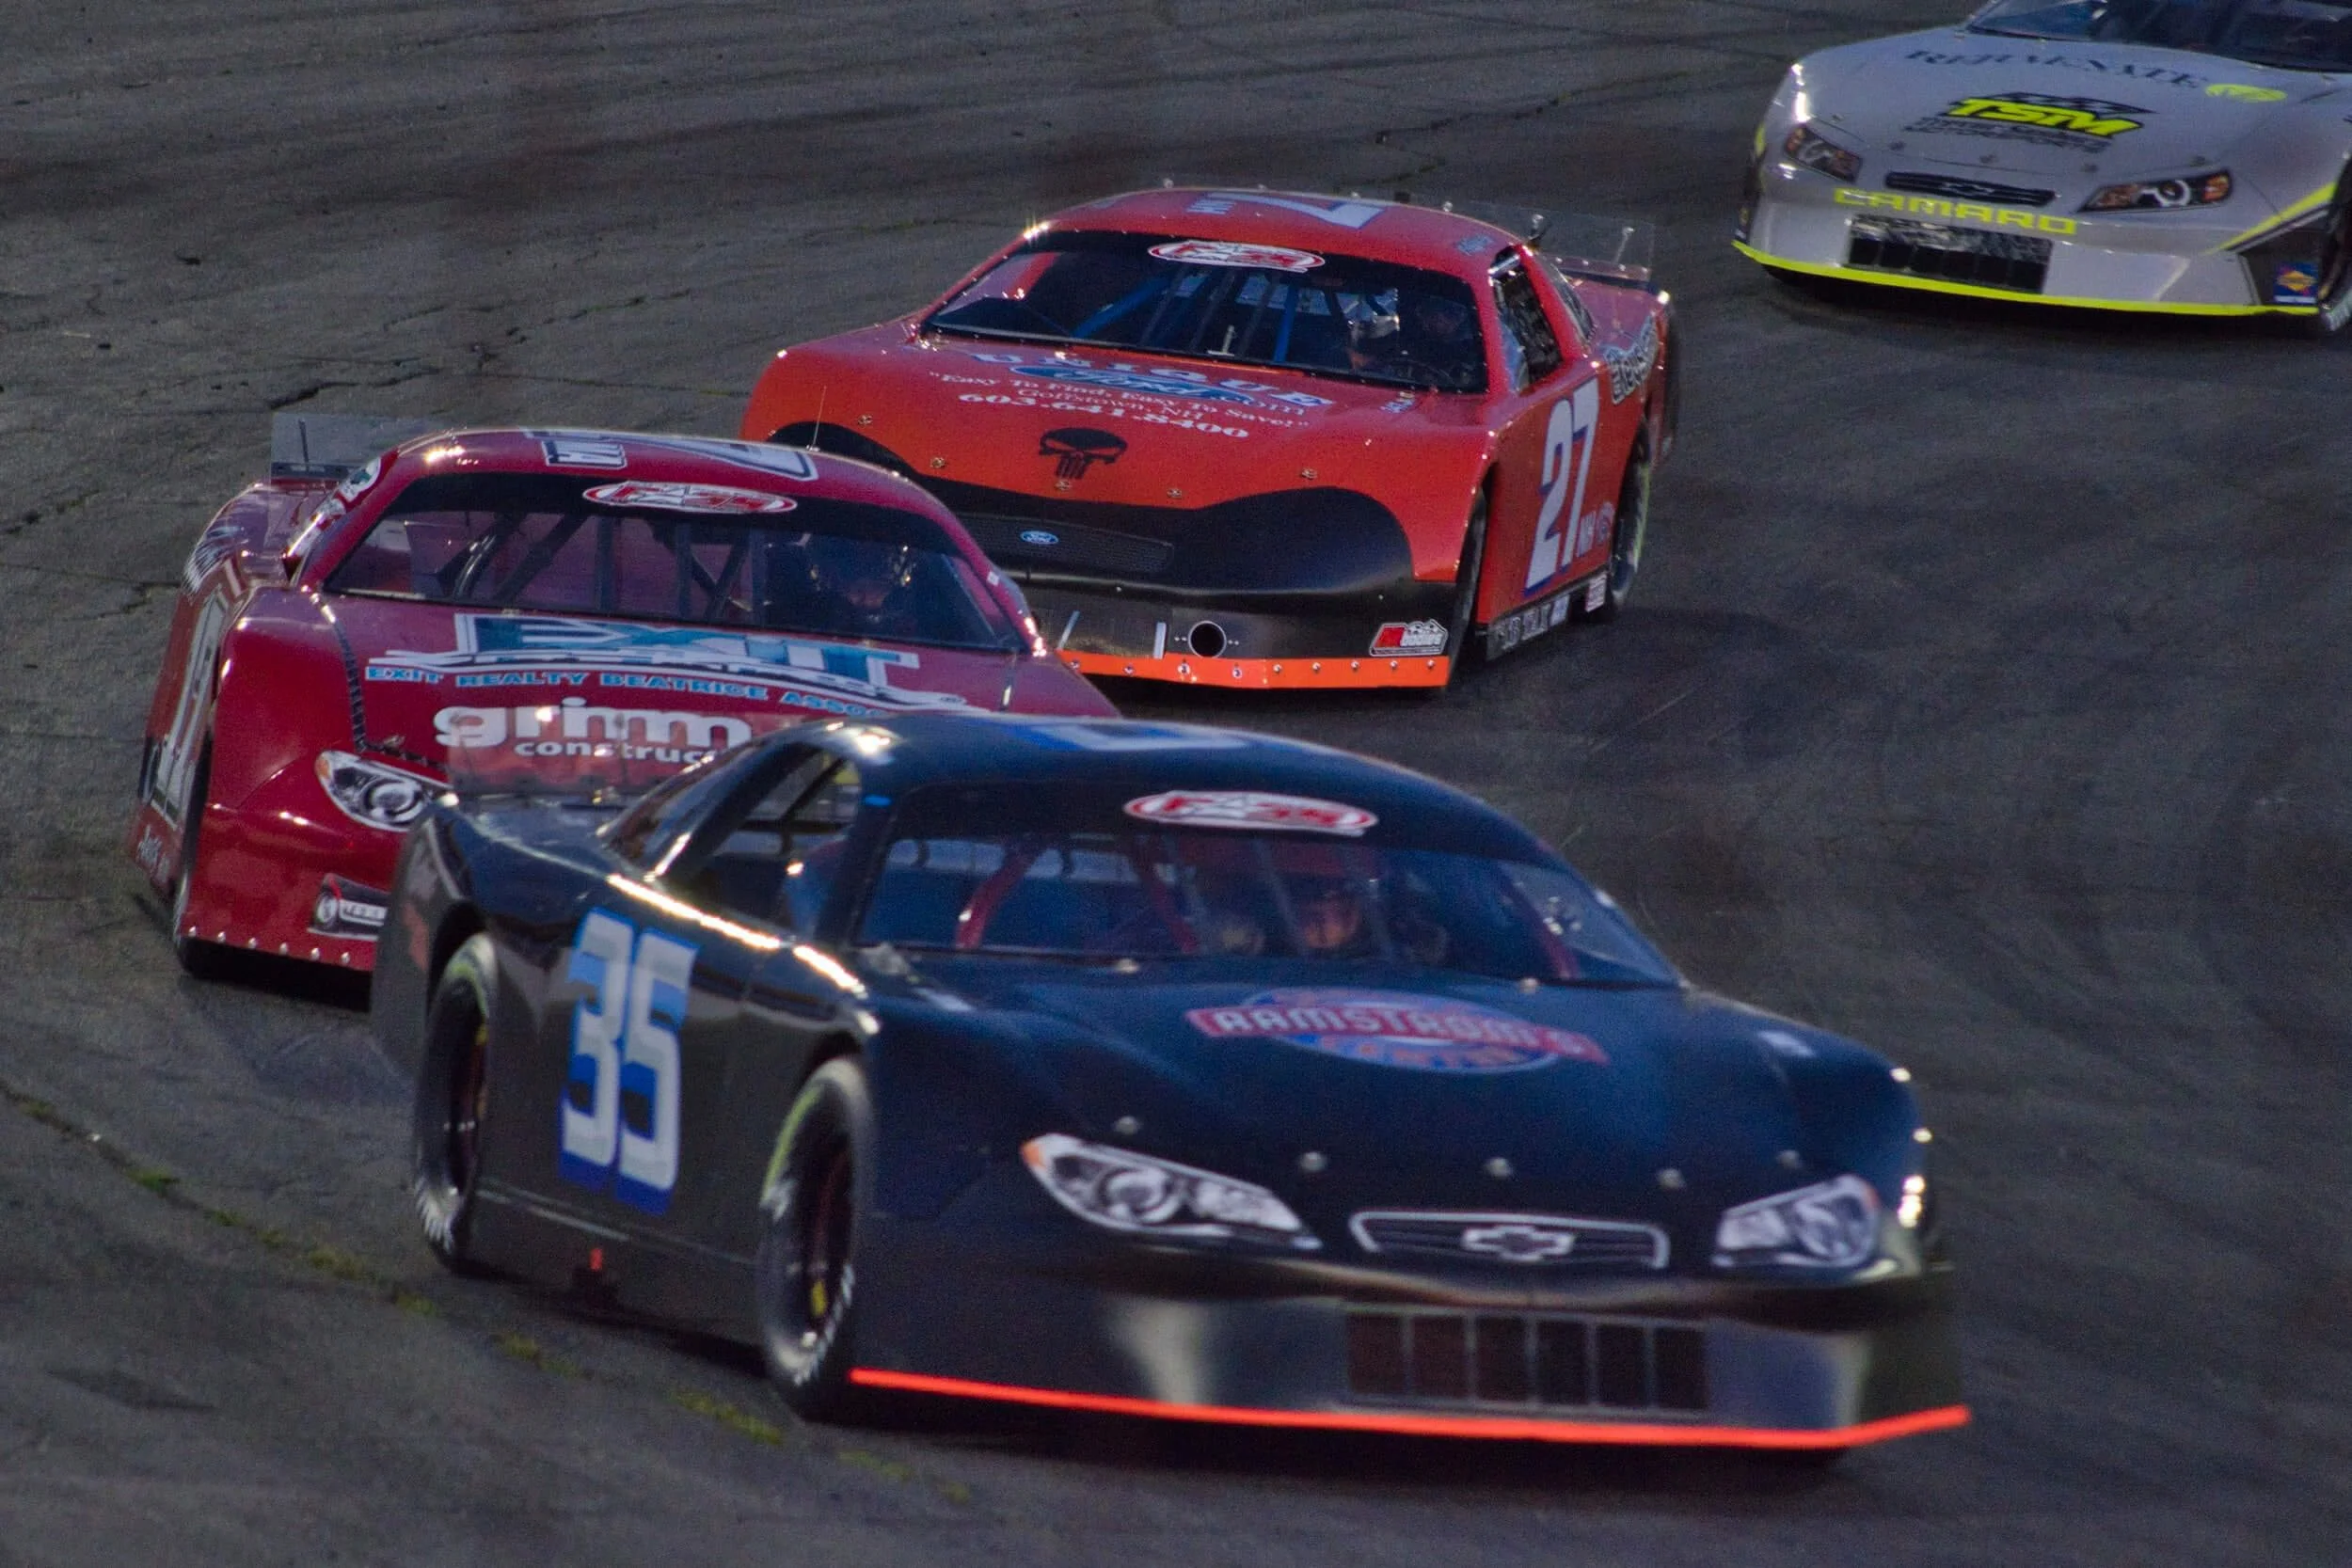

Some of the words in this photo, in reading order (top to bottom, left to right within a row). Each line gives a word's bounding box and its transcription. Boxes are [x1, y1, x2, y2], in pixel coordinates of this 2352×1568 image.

[1835, 187, 2076, 234] CAMARO
[1523, 377, 1599, 597] 27
[455, 613, 921, 689] EXIT
[365, 666, 444, 685] EXIT
[455, 671, 591, 689] REALTY
[599, 673, 769, 701] BEATRICE
[433, 696, 752, 748] grimm
[558, 907, 700, 1212] 35
